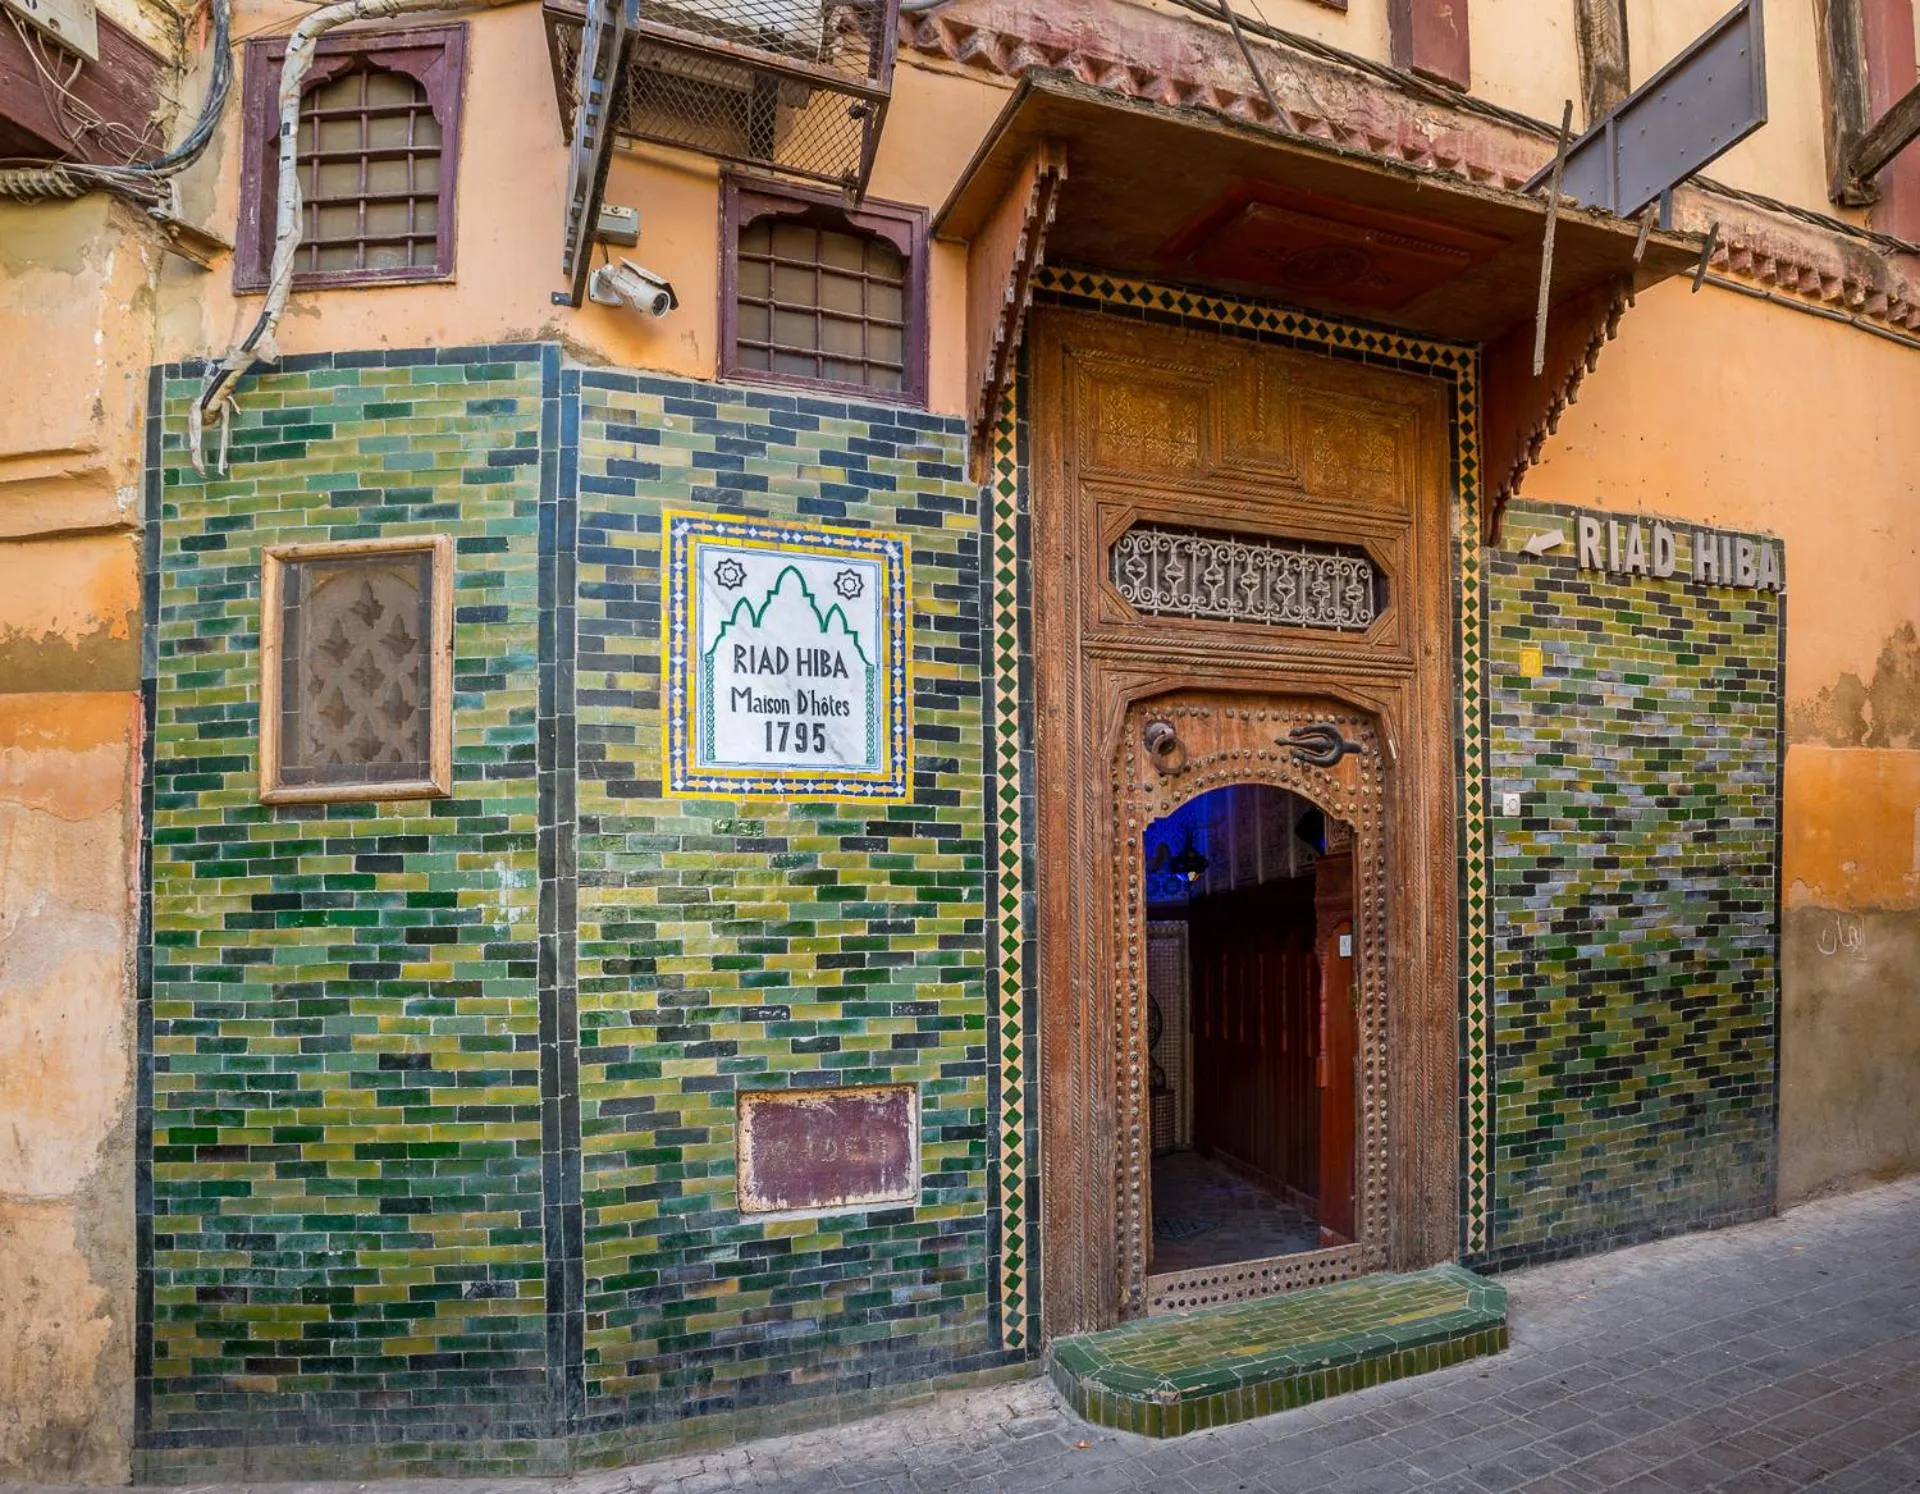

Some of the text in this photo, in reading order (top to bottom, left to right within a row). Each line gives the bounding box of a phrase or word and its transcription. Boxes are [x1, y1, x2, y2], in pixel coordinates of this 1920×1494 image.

[1576, 515, 1784, 592] RIAD HIBA
[733, 644, 849, 679] RIAD HIBA
[731, 686, 790, 715] Maison
[765, 720, 826, 754] 1795
